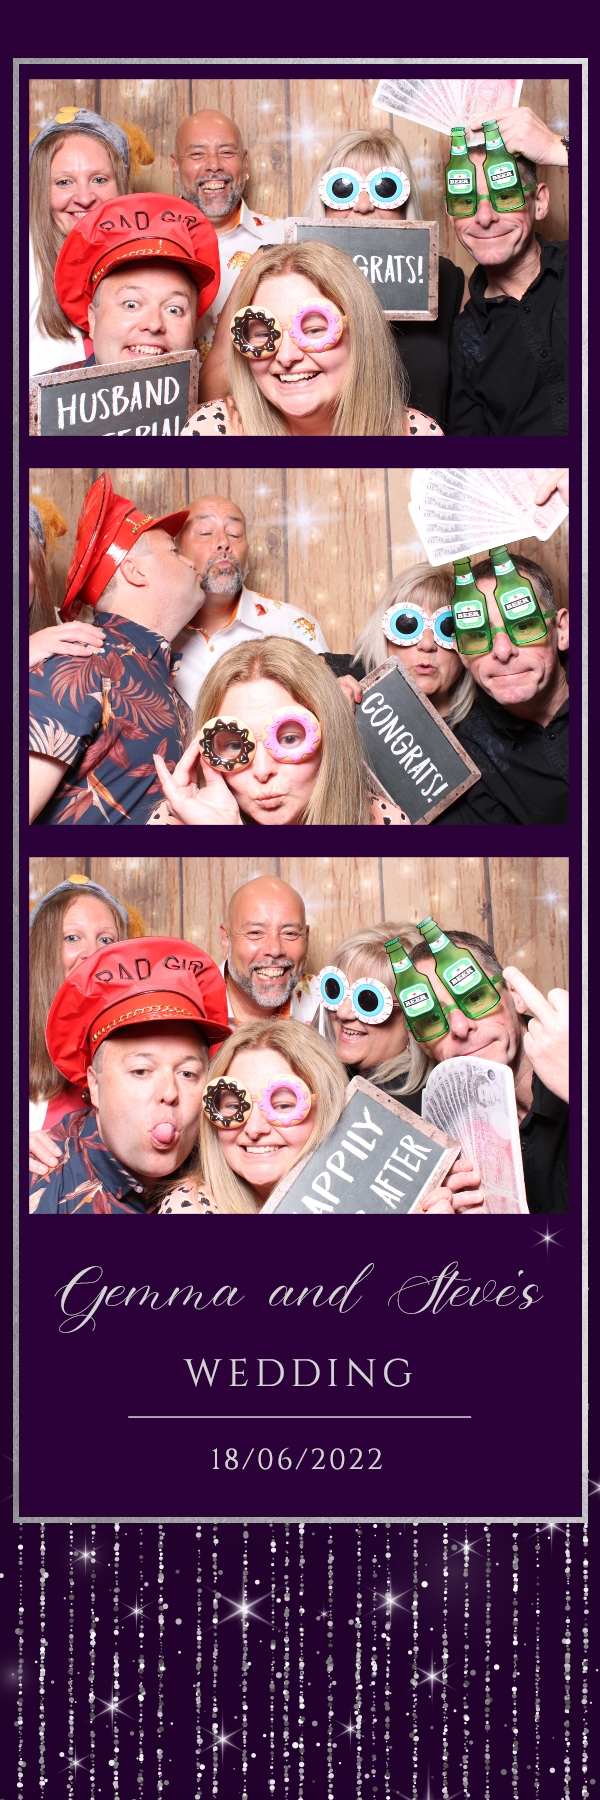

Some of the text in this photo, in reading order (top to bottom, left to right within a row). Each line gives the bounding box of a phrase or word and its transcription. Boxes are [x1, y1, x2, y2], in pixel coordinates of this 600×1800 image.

[353, 254, 424, 284] GRATS!
[57, 376, 180, 430] HUSBAND
[457, 610, 480, 619] BEER
[505, 597, 530, 611] BEER
[361, 692, 449, 803] CONGRATS!
[294, 1106, 383, 1213] APPILY
[369, 1135, 432, 1209] AFTER
